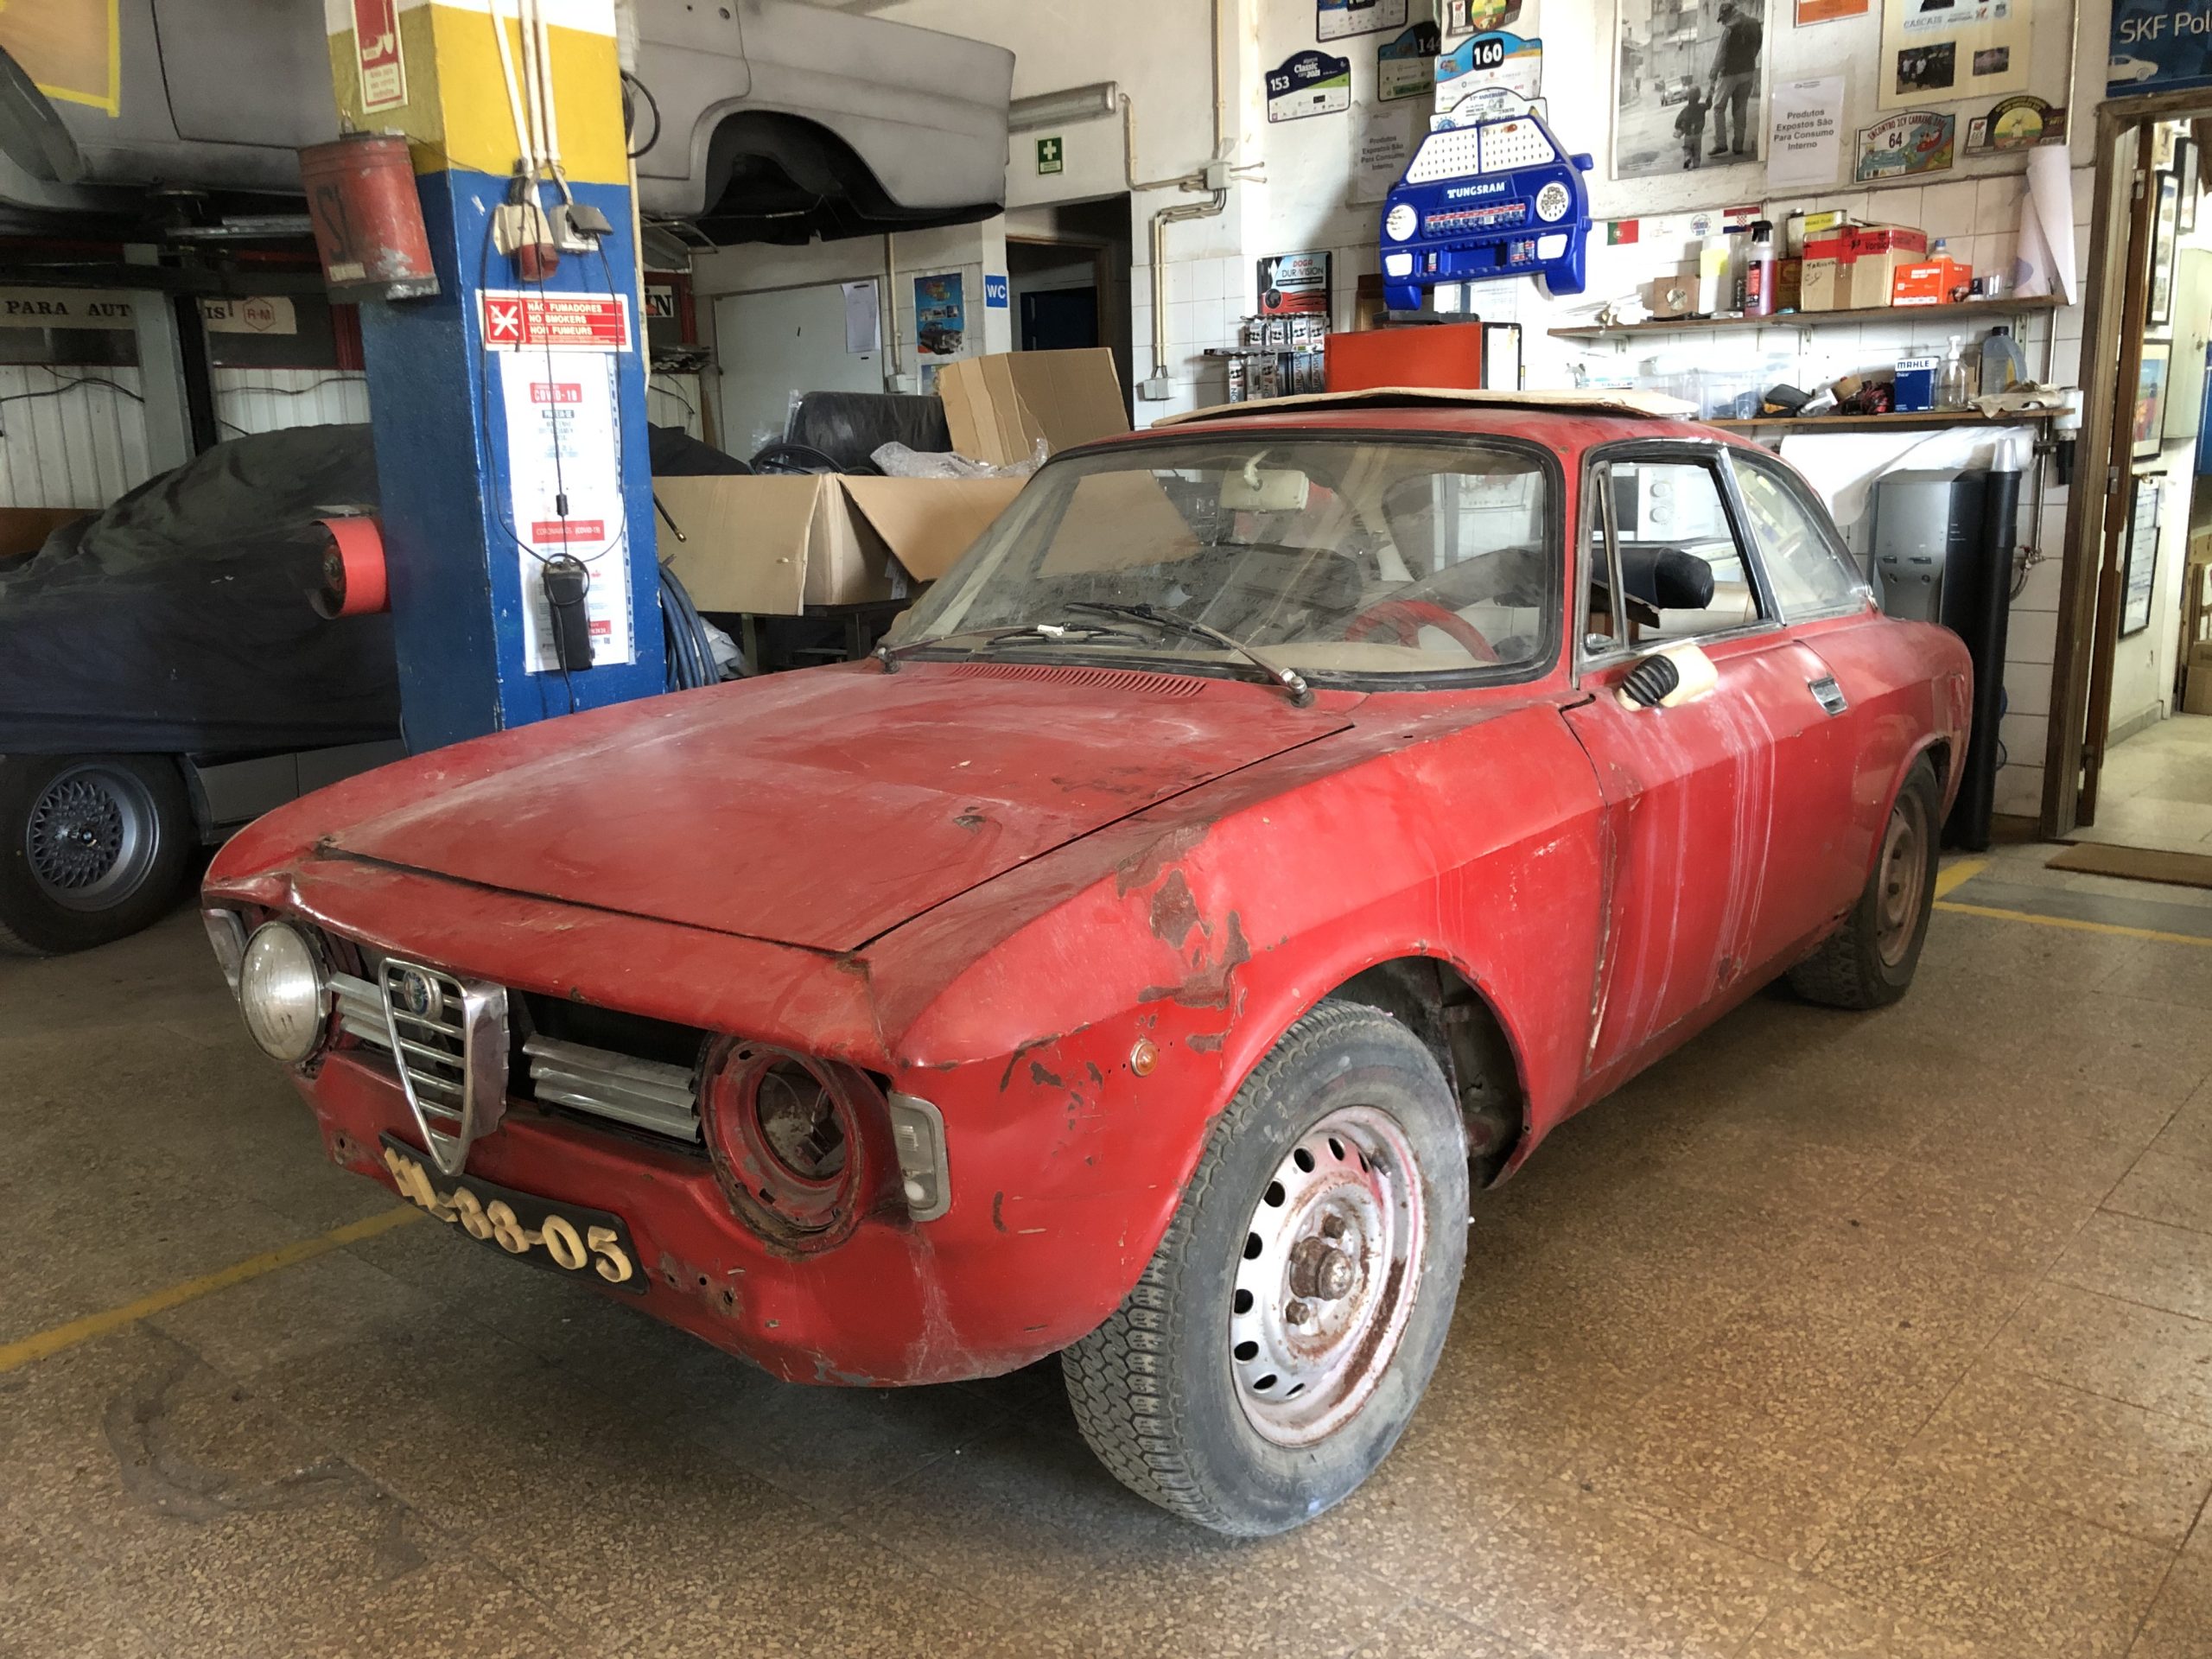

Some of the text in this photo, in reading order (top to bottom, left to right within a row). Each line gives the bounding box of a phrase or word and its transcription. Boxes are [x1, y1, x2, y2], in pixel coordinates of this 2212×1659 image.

[2120, 10, 2212, 44] SKF Pol
[1474, 43, 1503, 66] 160
[1294, 62, 1318, 73] Classic
[1270, 75, 1290, 91] 153
[1787, 109, 1825, 119] Produtos
[1777, 118, 1834, 132] Expostos São
[1867, 120, 1896, 140] ENCONTRO
[1794, 130, 1834, 139] Consumo
[1889, 131, 1903, 149] 64
[1788, 141, 1817, 150] Interno
[1446, 181, 1505, 199] TUNGSRAM
[1293, 259, 1313, 268] DOGA
[987, 284, 1007, 299] WC
[5, 301, 69, 315] PARA
[88, 303, 130, 317] AUT
[527, 301, 602, 313] NÃO FUMADORES
[528, 315, 587, 324] NO SMOKERS
[530, 326, 593, 335] NON FUMEURS
[1897, 359, 1929, 369] MAHLE
[535, 389, 578, 401] COVID-19
